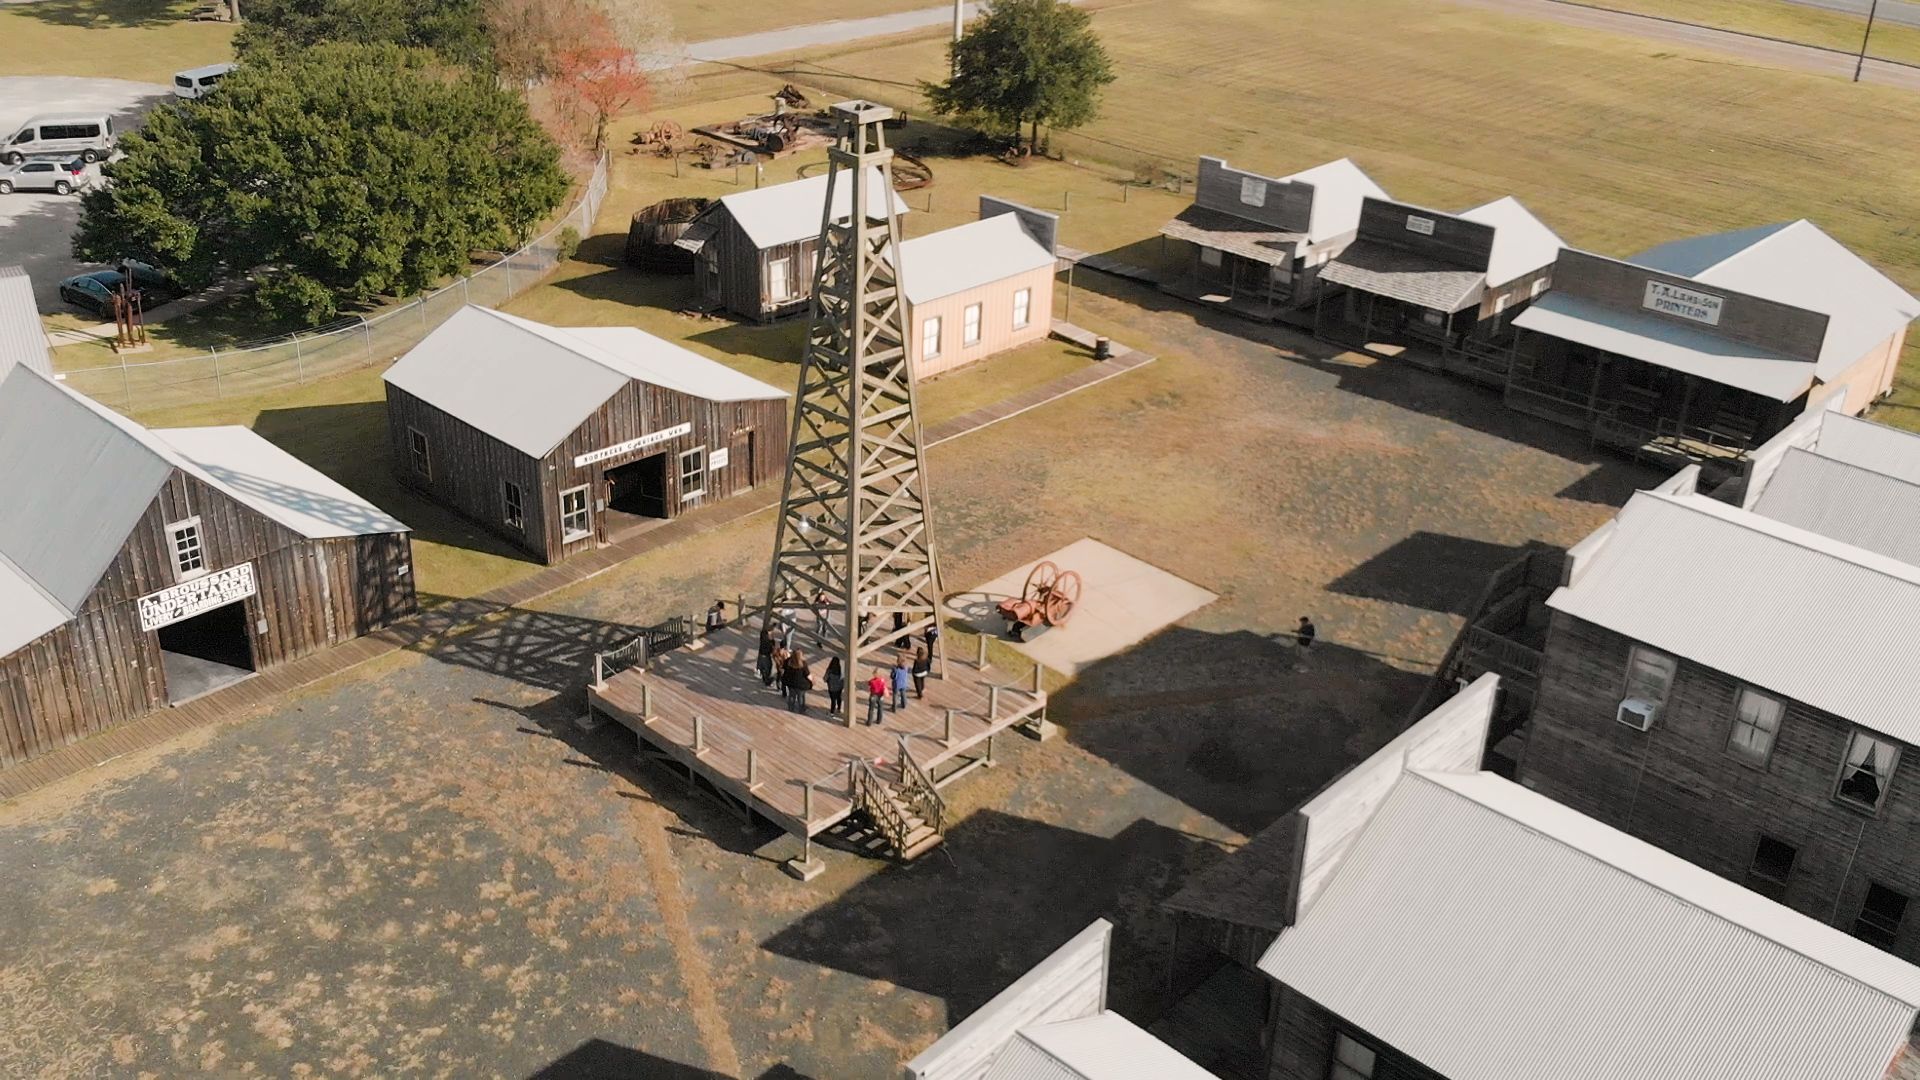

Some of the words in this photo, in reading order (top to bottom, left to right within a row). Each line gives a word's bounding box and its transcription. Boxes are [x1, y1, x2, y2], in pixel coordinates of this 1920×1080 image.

[1655, 298, 1708, 318] PRINTERS
[142, 598, 158, 609] A.
[160, 566, 250, 602] BROUSSARD
[142, 574, 251, 619] UNDERTAKER
[144, 611, 174, 628] LIVERY
[182, 593, 222, 616] BOARDING
[222, 583, 253, 602] STABLE
